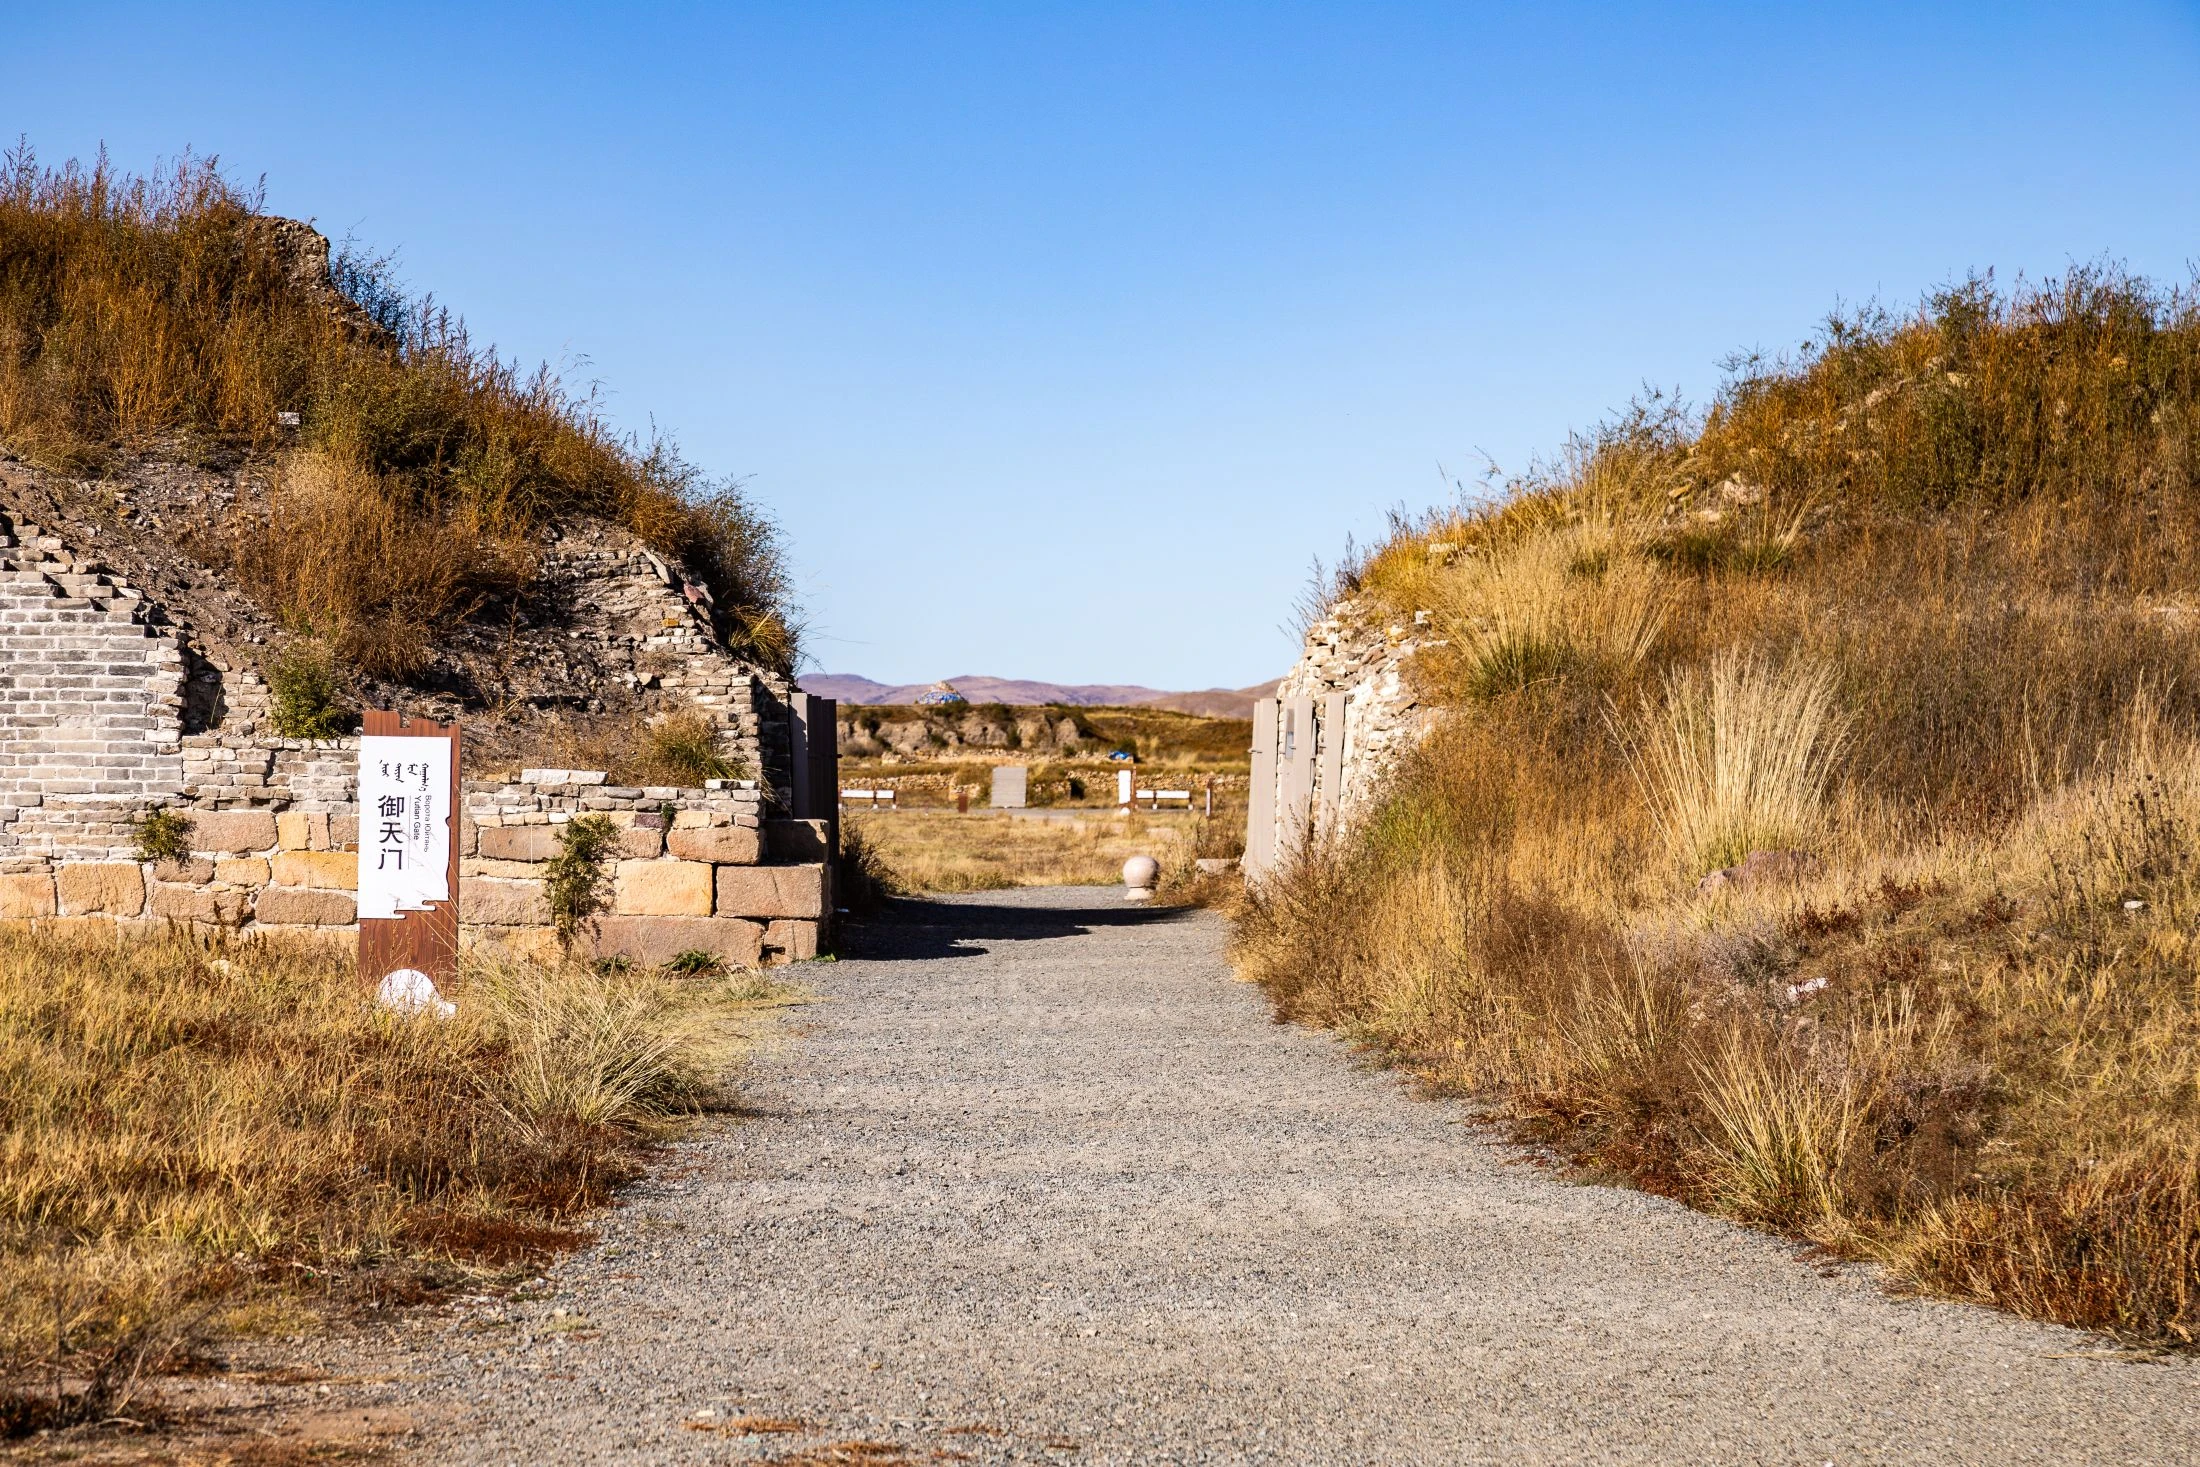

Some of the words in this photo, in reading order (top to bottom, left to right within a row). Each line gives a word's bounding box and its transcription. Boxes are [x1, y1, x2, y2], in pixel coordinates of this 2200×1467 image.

[413, 795, 422, 820] Yutian
[423, 794, 432, 822] Ворота
[378, 795, 405, 870] 御天门
[413, 821, 421, 841] Gate
